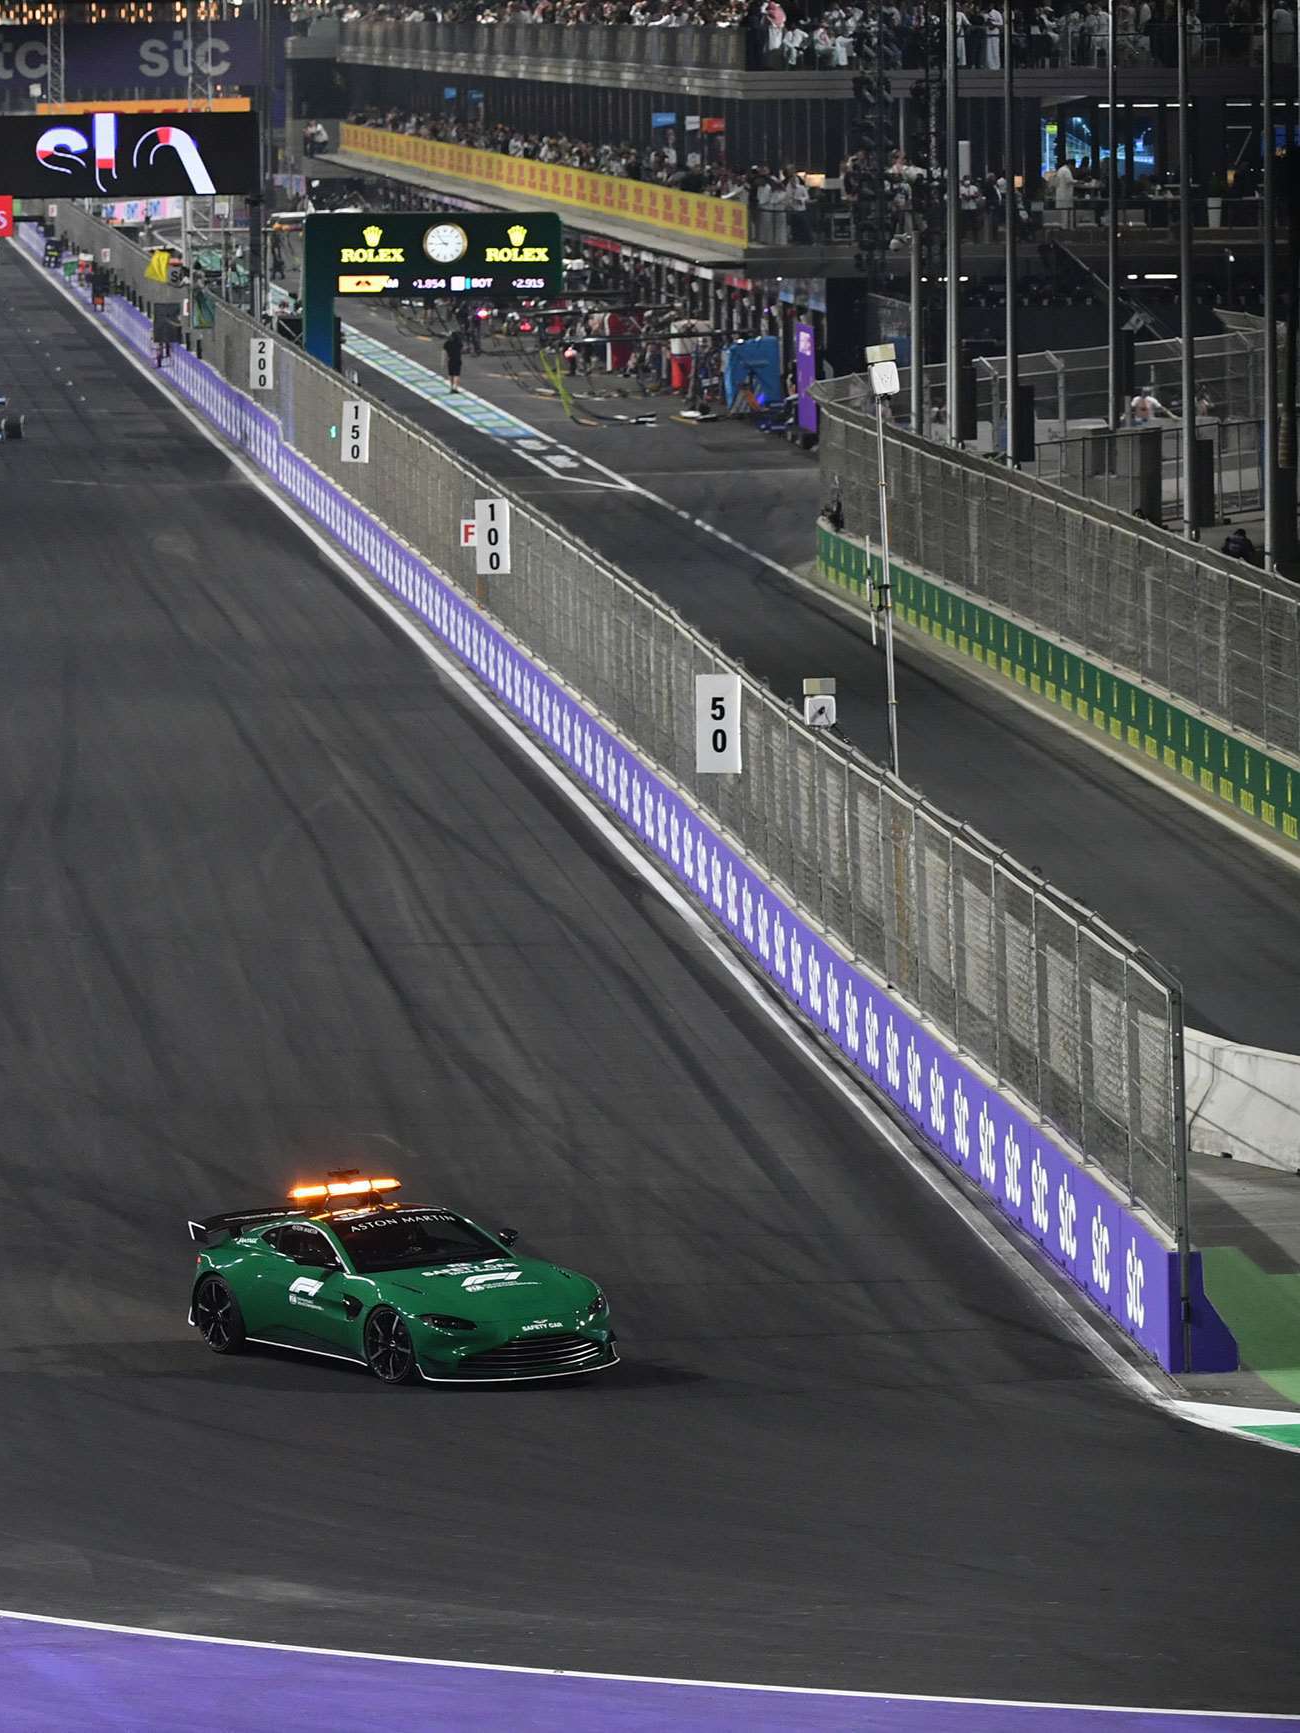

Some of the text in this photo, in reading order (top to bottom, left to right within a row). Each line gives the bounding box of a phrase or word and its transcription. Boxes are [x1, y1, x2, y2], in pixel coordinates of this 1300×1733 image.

[139, 30, 232, 78] stc
[341, 248, 405, 263] ROLEX
[485, 247, 549, 262] ROLEX
[463, 524, 475, 544] F
[885, 1015, 901, 1089] stc
[906, 1035, 923, 1111] stc
[929, 1057, 947, 1135] stc
[953, 1078, 971, 1159] stc
[978, 1101, 997, 1183] stc
[1004, 1124, 1022, 1207] stc
[1031, 1148, 1050, 1232] stc
[1058, 1173, 1078, 1260] stc
[1091, 1204, 1111, 1293] stc
[1126, 1237, 1145, 1328] stc
[350, 1213, 456, 1233] ASTON MARTIN
[521, 1323, 548, 1331] SAFETY
